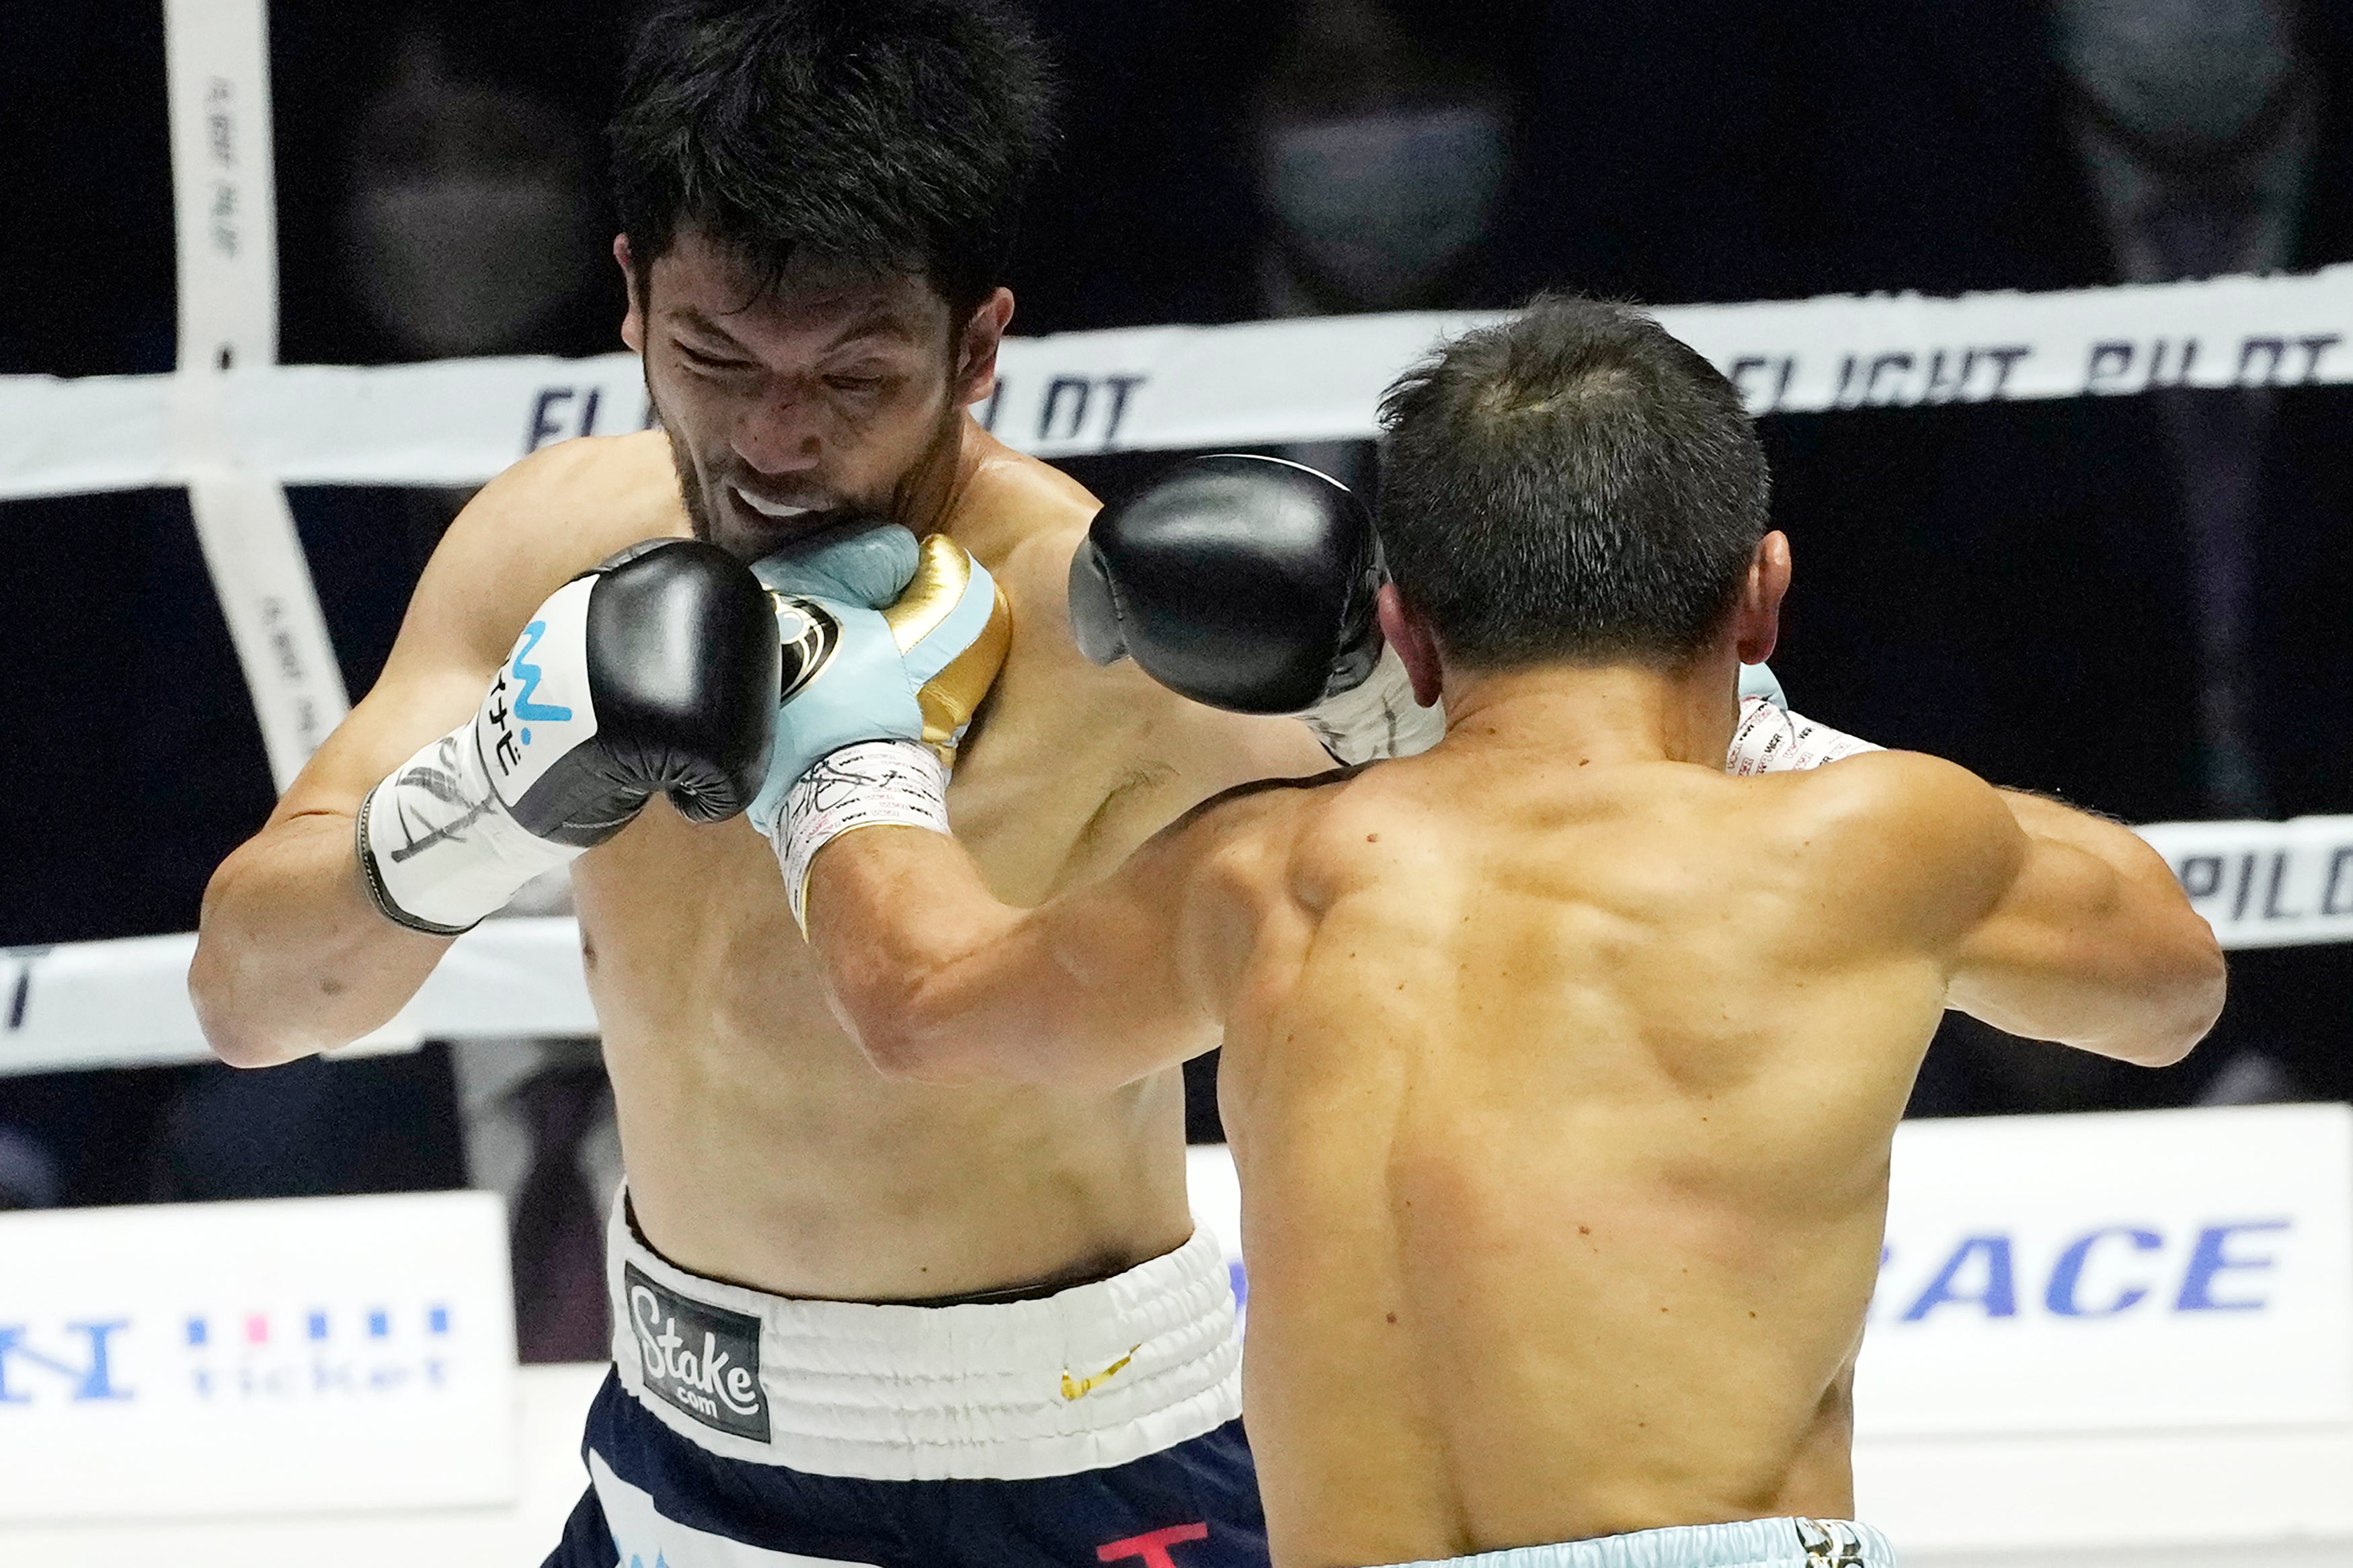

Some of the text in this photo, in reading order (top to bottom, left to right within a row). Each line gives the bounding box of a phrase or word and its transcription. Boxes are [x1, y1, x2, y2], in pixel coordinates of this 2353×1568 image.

[490, 659, 521, 776] イナビ
[1880, 1218, 2290, 1323] ACE
[631, 1285, 760, 1415] Stake
[676, 1386, 718, 1418] com
